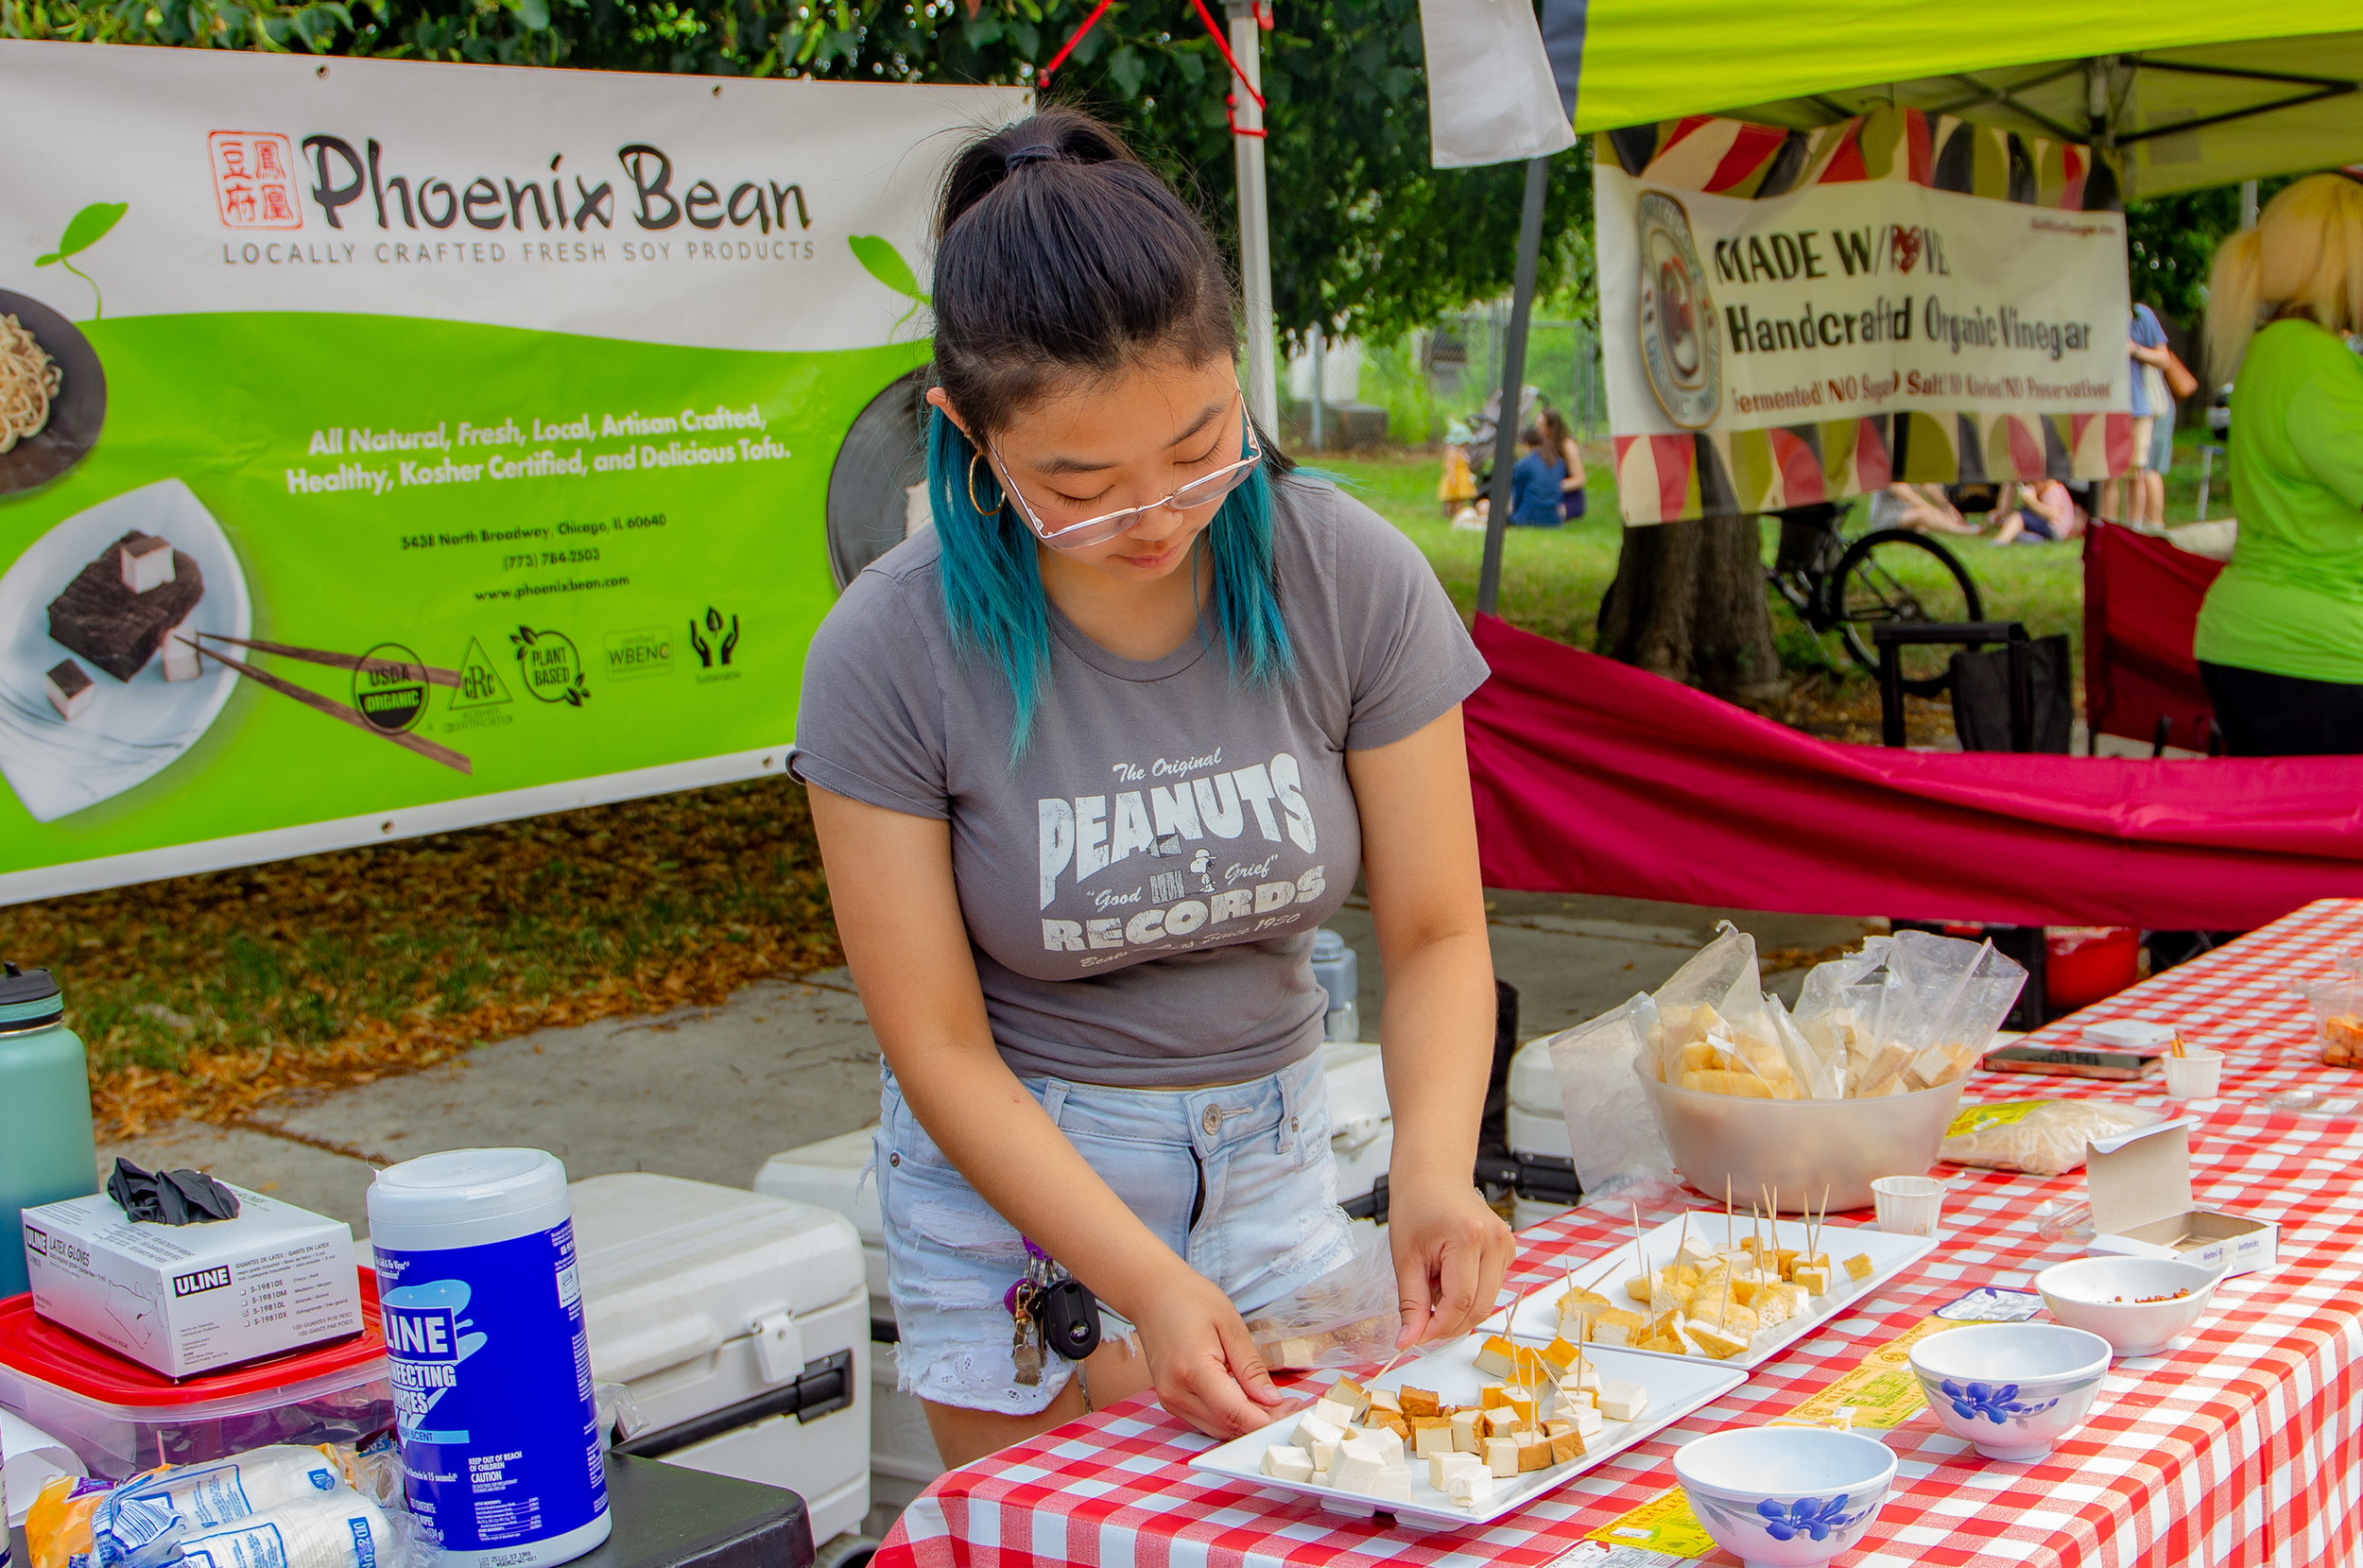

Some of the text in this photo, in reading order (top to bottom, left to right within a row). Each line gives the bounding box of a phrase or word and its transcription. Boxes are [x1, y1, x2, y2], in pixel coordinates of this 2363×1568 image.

[302, 134, 813, 235] Phoenix Bean
[223, 239, 816, 266] LOCALLY CRAFTED FRESH SOY PRODUCTS
[1714, 230, 1828, 284] MADE
[1725, 294, 1915, 353] Handcraftd
[1996, 303, 2093, 361] Vinegar
[1827, 375, 1857, 404] NO
[309, 404, 768, 457] All Natural, Fresh, Local, Artisan Crafted,
[286, 435, 791, 495] Healthy, Kosher Certified, and Delicious Tofu.
[440, 528, 478, 547] North
[482, 524, 555, 545] Broadway,
[558, 519, 610, 538] Chicago,
[613, 517, 624, 531] IL
[627, 513, 666, 530] 60640
[504, 553, 538, 571] (773)
[474, 575, 630, 603] www.phoenixbean.com
[532, 647, 567, 666] PLANT
[610, 643, 670, 666] WBENC
[369, 664, 411, 686] USDA
[535, 667, 571, 686] BASED
[697, 670, 743, 684] Sustainable
[365, 690, 420, 713] ORGANIC
[1113, 746, 1223, 784] The Original
[1038, 752, 1317, 912] PEANUTS
[1042, 865, 1326, 953] RECORDS
[1201, 913, 1302, 945] Since 1950
[26, 1228, 46, 1254] ULINE
[50, 1236, 66, 1257] LATEX
[67, 1245, 90, 1266] GLOVES
[235, 1259, 260, 1269] GUANTES
[287, 1248, 305, 1257] GANTS
[314, 1242, 330, 1251] LATEX
[176, 1268, 229, 1295] ULINE
[250, 1279, 284, 1293] S-19810S
[251, 1289, 287, 1304] S-19810M
[252, 1301, 285, 1315] S-19810L
[253, 1311, 287, 1325] S-19810X
[303, 1318, 327, 1329] GUANTES
[338, 1311, 354, 1320] PESO
[308, 1325, 326, 1335] GANTS
[326, 1321, 337, 1330] PAR
[337, 1318, 354, 1328] POIDS
[383, 1311, 449, 1353] LINE
[410, 1430, 433, 1442] SCENT
[468, 1451, 523, 1466] KEEP OUT OF REACH
[469, 1461, 506, 1473] OF CHILDREN
[471, 1471, 503, 1483] CAUTION
